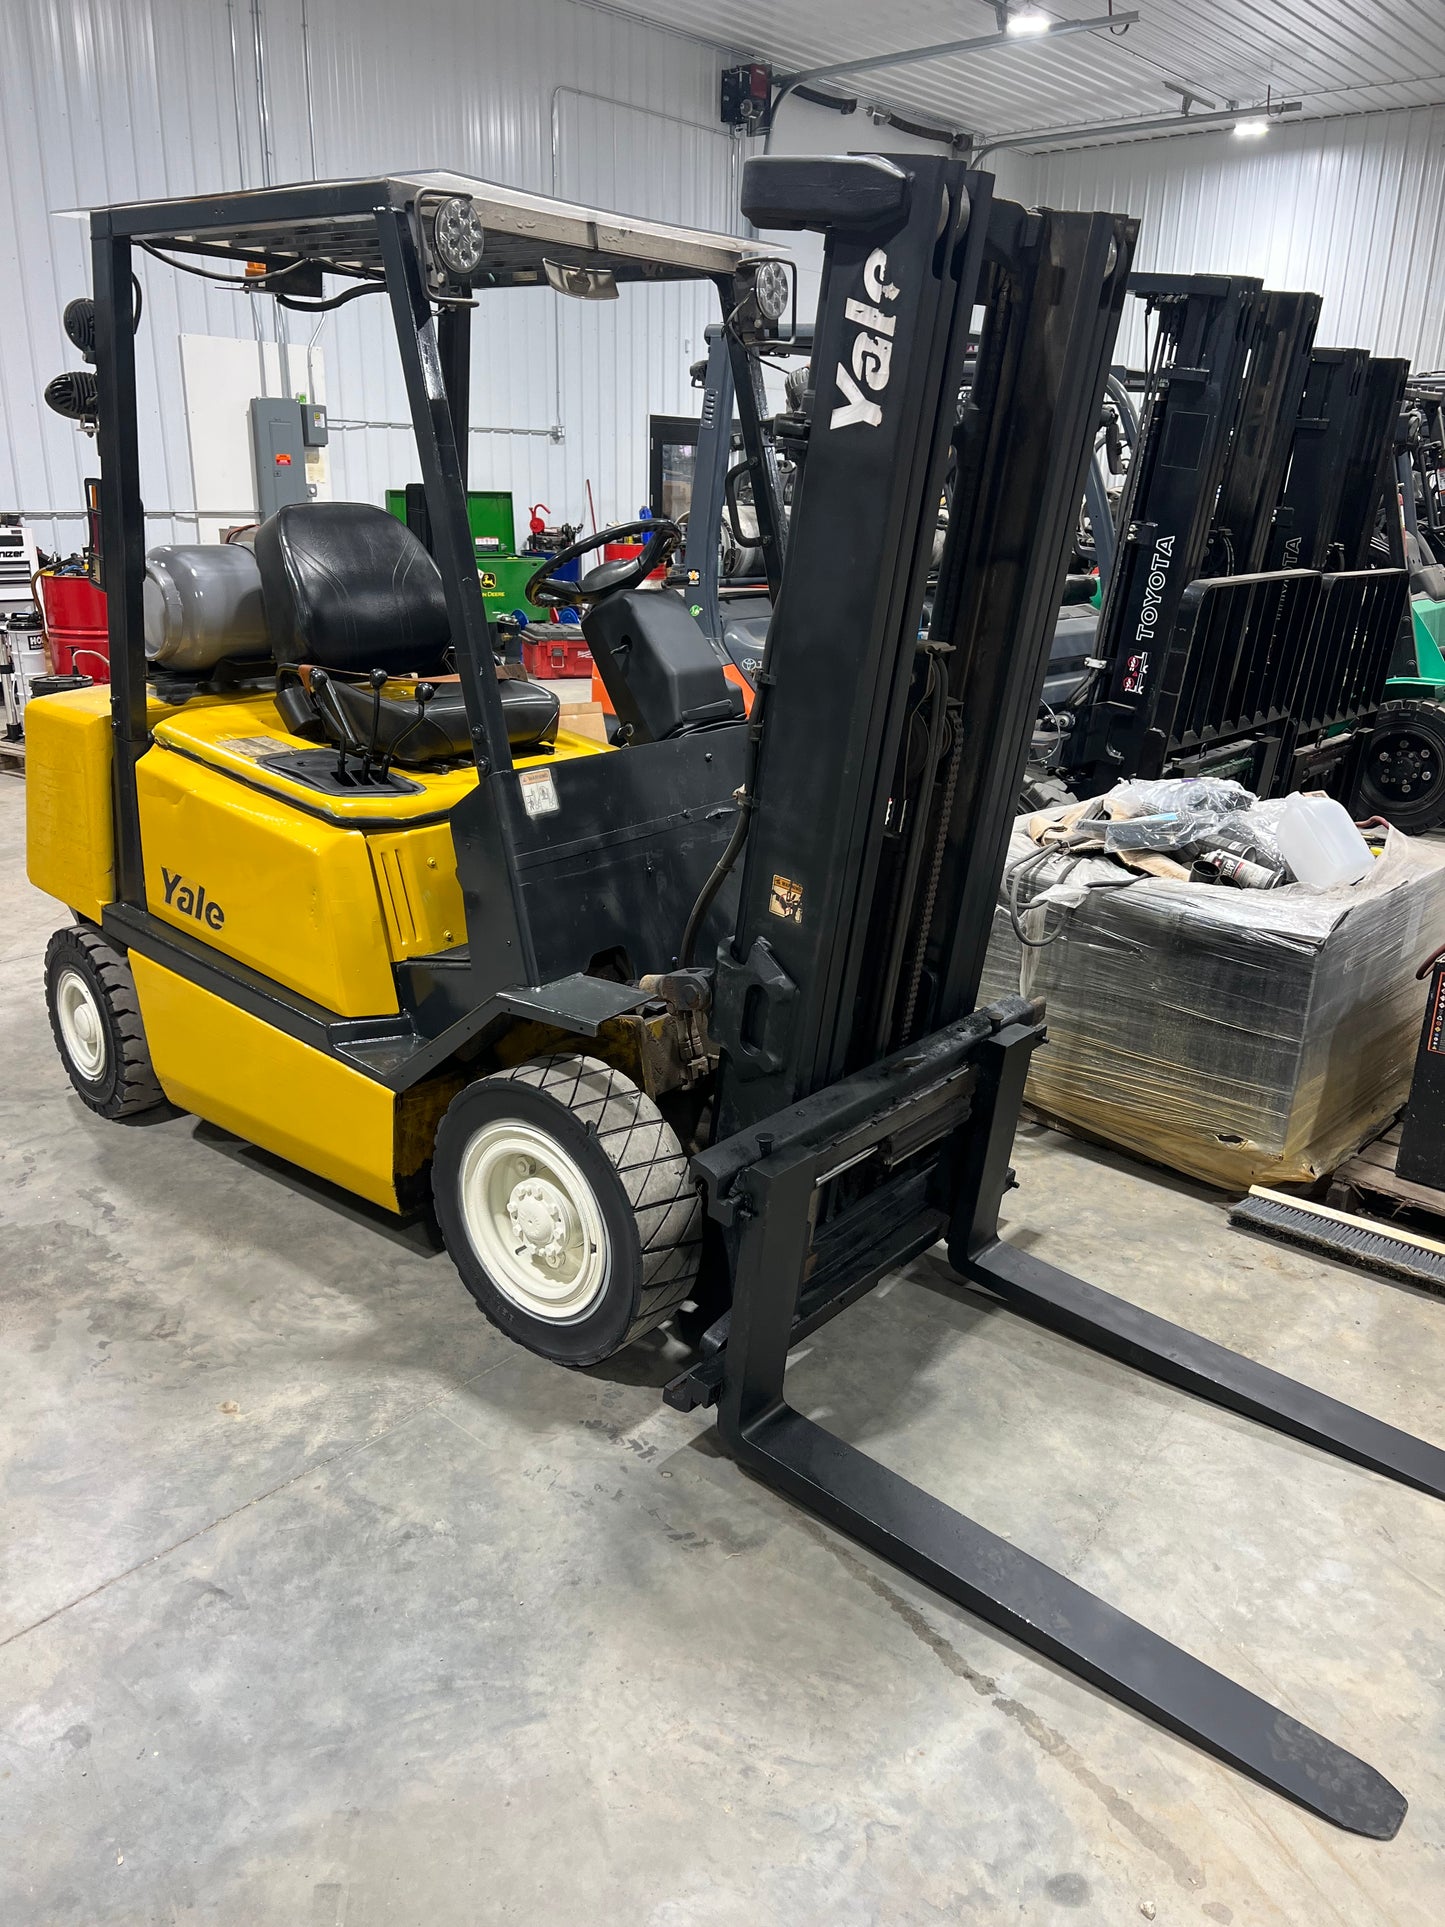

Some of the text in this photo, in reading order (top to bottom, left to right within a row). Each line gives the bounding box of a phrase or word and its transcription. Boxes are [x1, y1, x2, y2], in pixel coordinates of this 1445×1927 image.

[829, 247, 901, 430] Yale
[1135, 535, 1176, 641] TOYOTA
[161, 866, 226, 931] Yale
